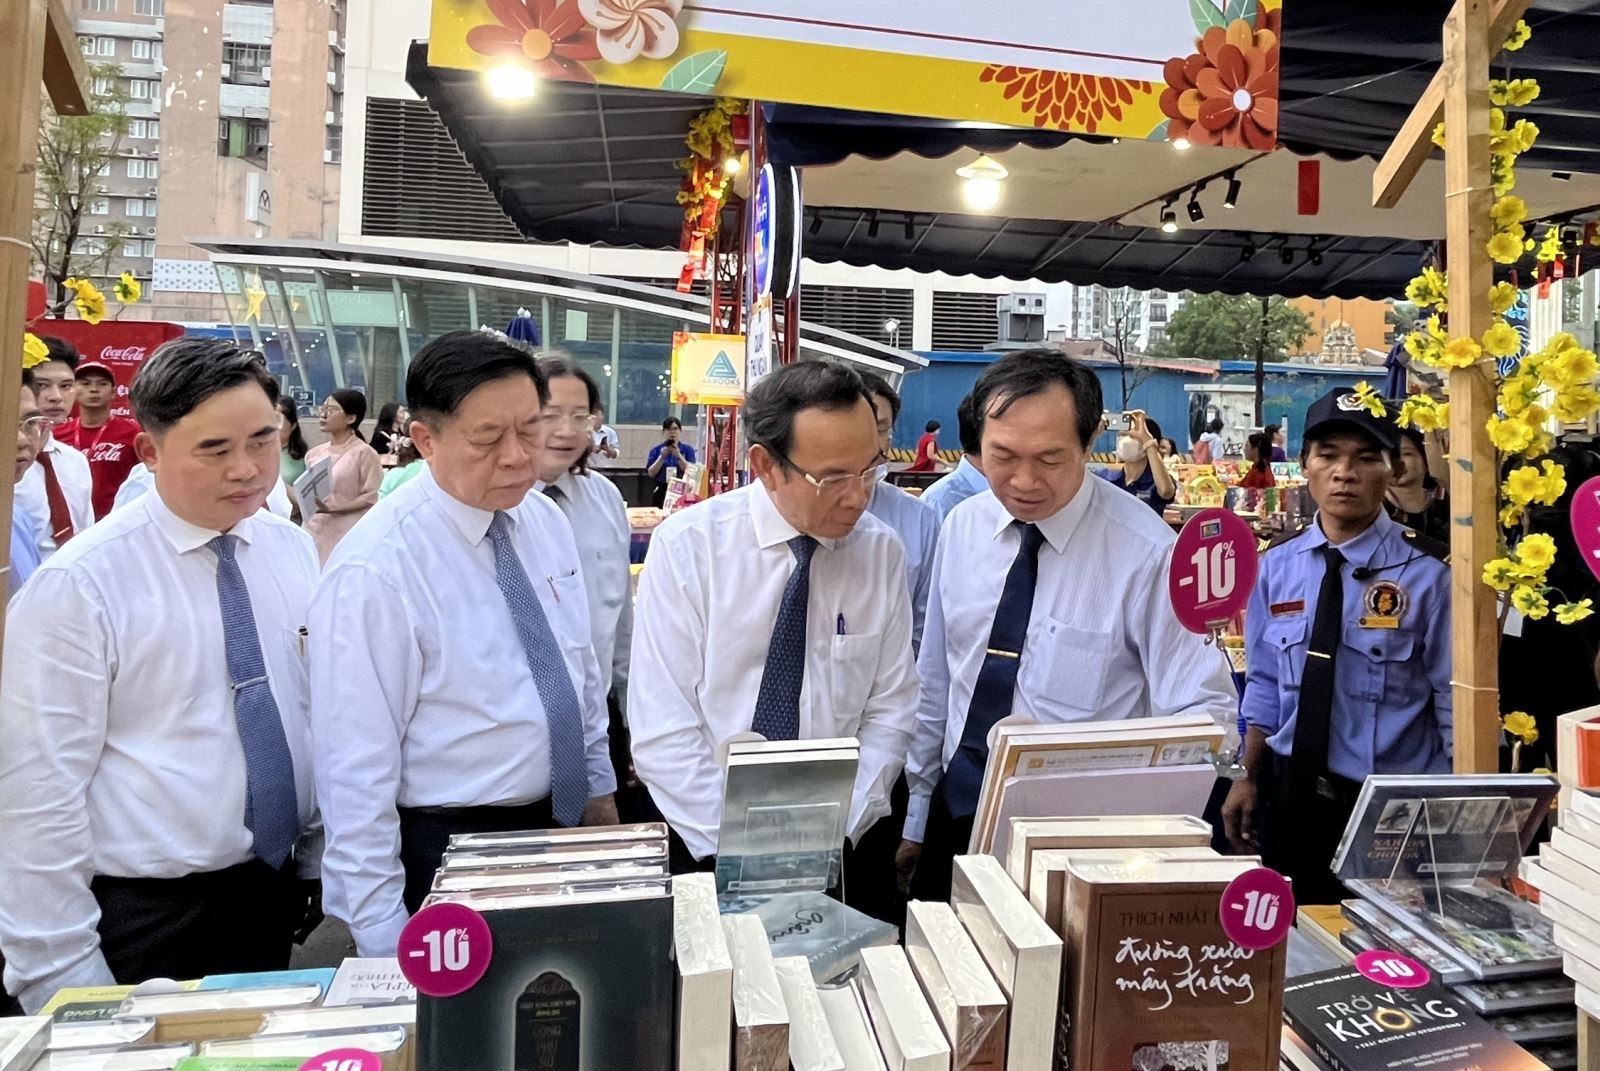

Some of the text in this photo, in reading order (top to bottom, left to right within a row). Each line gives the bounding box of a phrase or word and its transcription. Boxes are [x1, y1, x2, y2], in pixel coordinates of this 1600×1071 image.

[1179, 540, 1235, 603] -10%
[1231, 890, 1280, 931] -10%
[409, 927, 470, 972] -10%
[1325, 1000, 1459, 1042] KHÔNG
